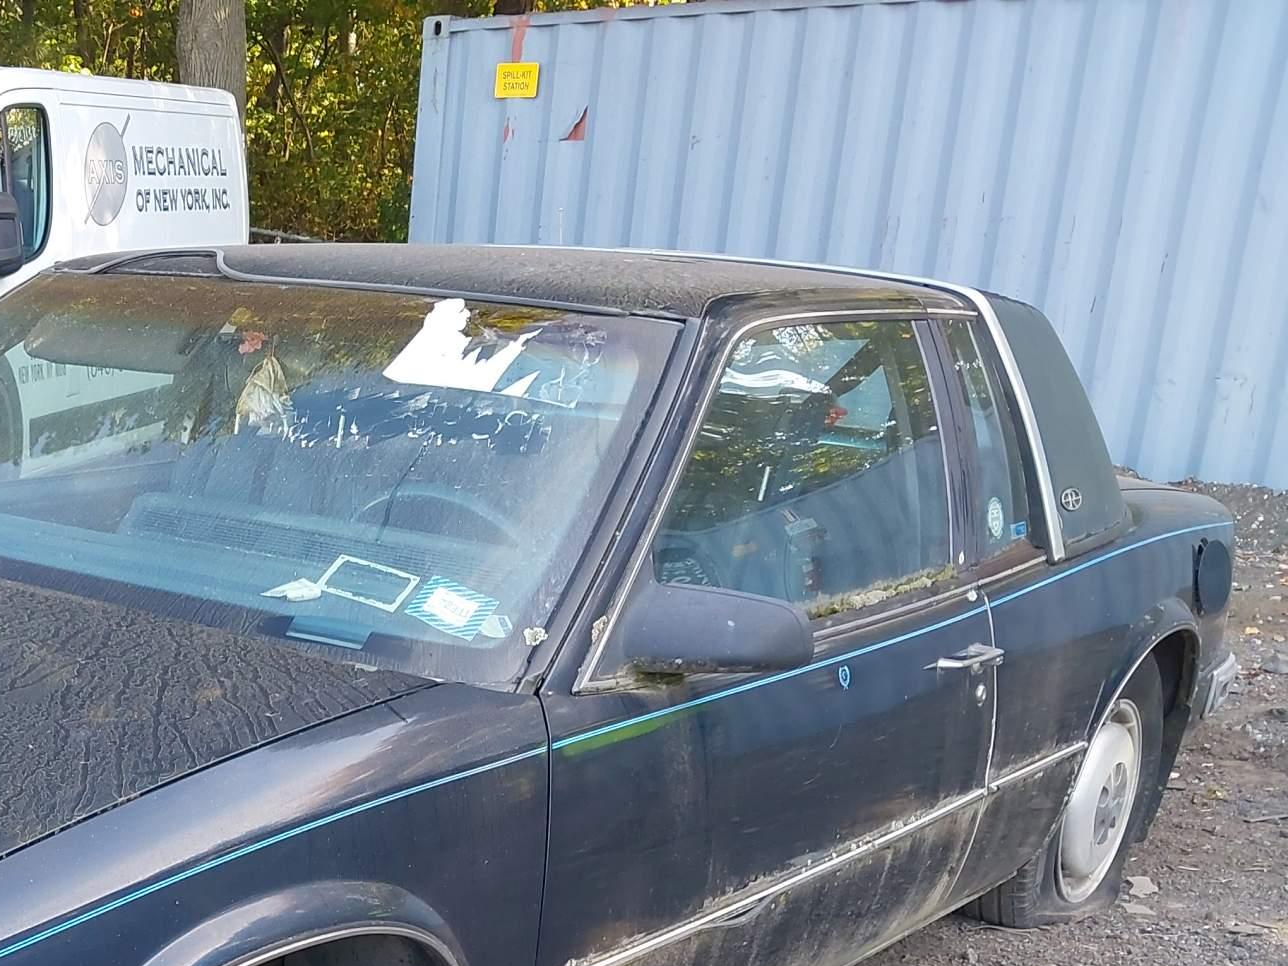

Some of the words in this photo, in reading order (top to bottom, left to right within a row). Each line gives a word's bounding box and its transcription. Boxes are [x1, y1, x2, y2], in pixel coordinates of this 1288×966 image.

[503, 82, 529, 91] STATION
[88, 159, 125, 184] AXIS
[131, 145, 228, 176] MECHANICAL
[135, 188, 150, 212] OF
[153, 188, 178, 212] NEW
